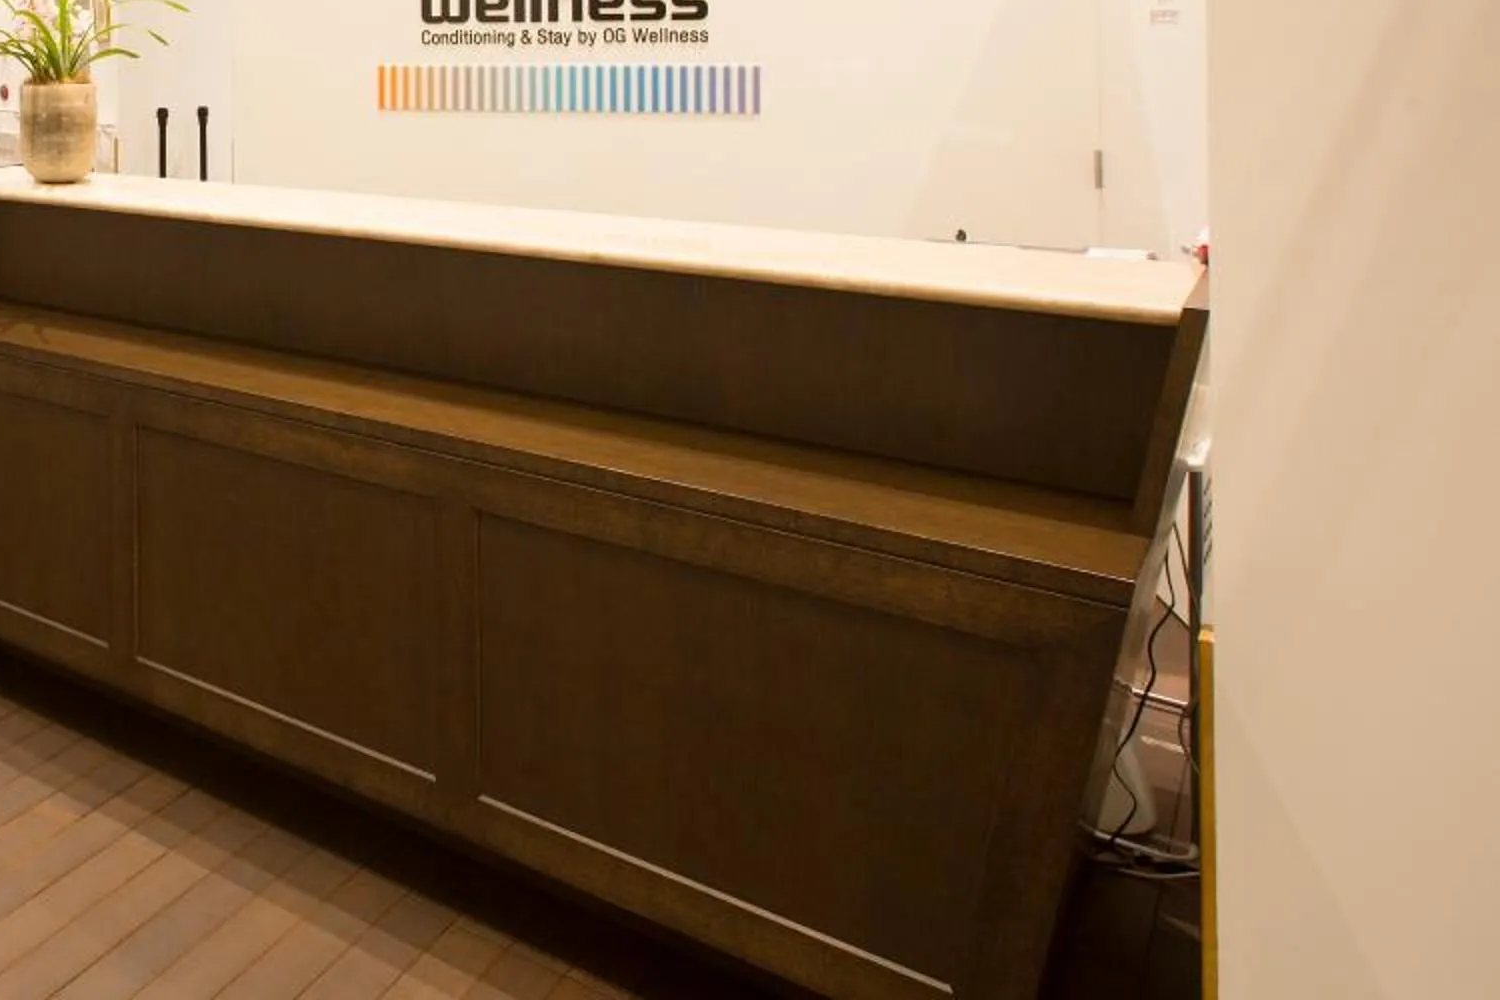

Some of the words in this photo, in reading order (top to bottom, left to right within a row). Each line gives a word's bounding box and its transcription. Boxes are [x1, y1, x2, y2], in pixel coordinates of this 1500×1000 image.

[421, 29, 515, 48] Conditioning
[520, 29, 532, 45] &
[537, 28, 572, 47] Stay
[577, 27, 597, 47] by
[603, 26, 626, 43] OG
[632, 27, 709, 43] Wellness
